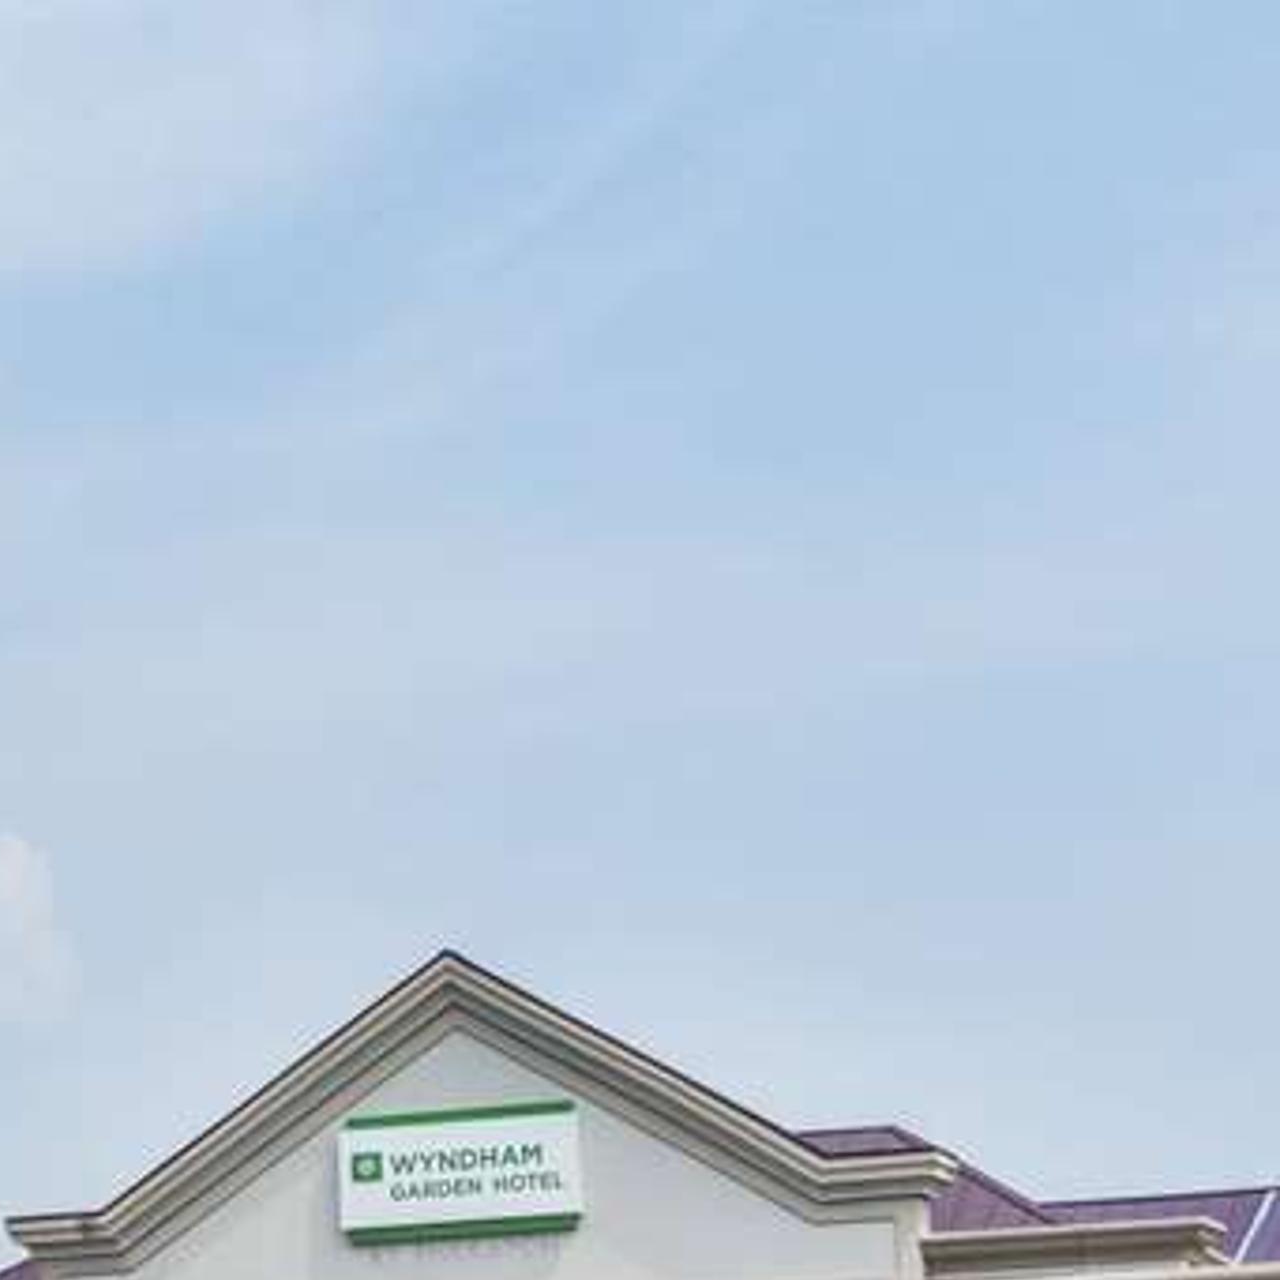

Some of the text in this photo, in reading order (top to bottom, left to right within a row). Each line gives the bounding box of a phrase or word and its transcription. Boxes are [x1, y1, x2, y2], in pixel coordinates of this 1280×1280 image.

[389, 1143, 544, 1175] WYNDHAM
[389, 1170, 562, 1202] GARDEN HOTEL
